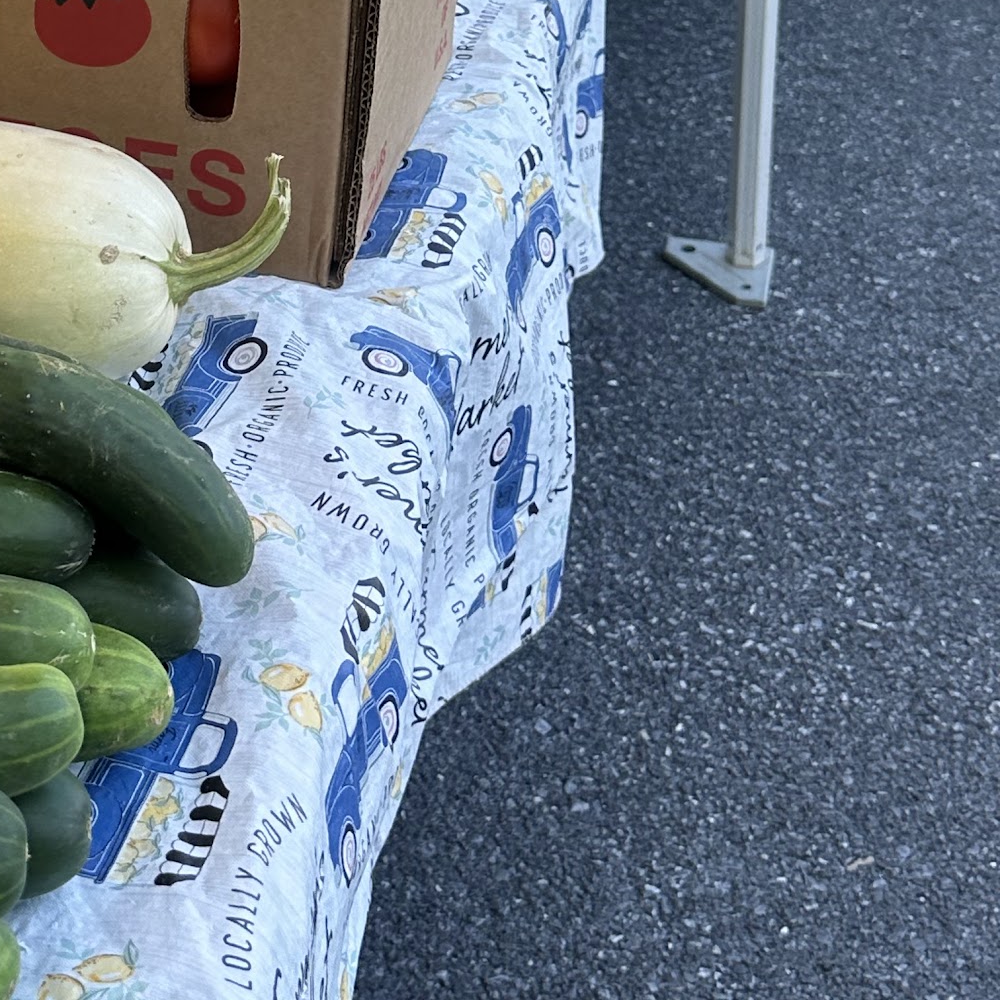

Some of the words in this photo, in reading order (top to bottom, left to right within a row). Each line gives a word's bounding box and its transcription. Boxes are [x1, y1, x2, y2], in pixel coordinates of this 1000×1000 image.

[242, 386, 290, 444] ORGANIC
[341, 375, 408, 405] FRESH
[311, 491, 390, 556] GROWN
[222, 866, 264, 990] LOCALLY
[247, 792, 308, 867] GROWN
